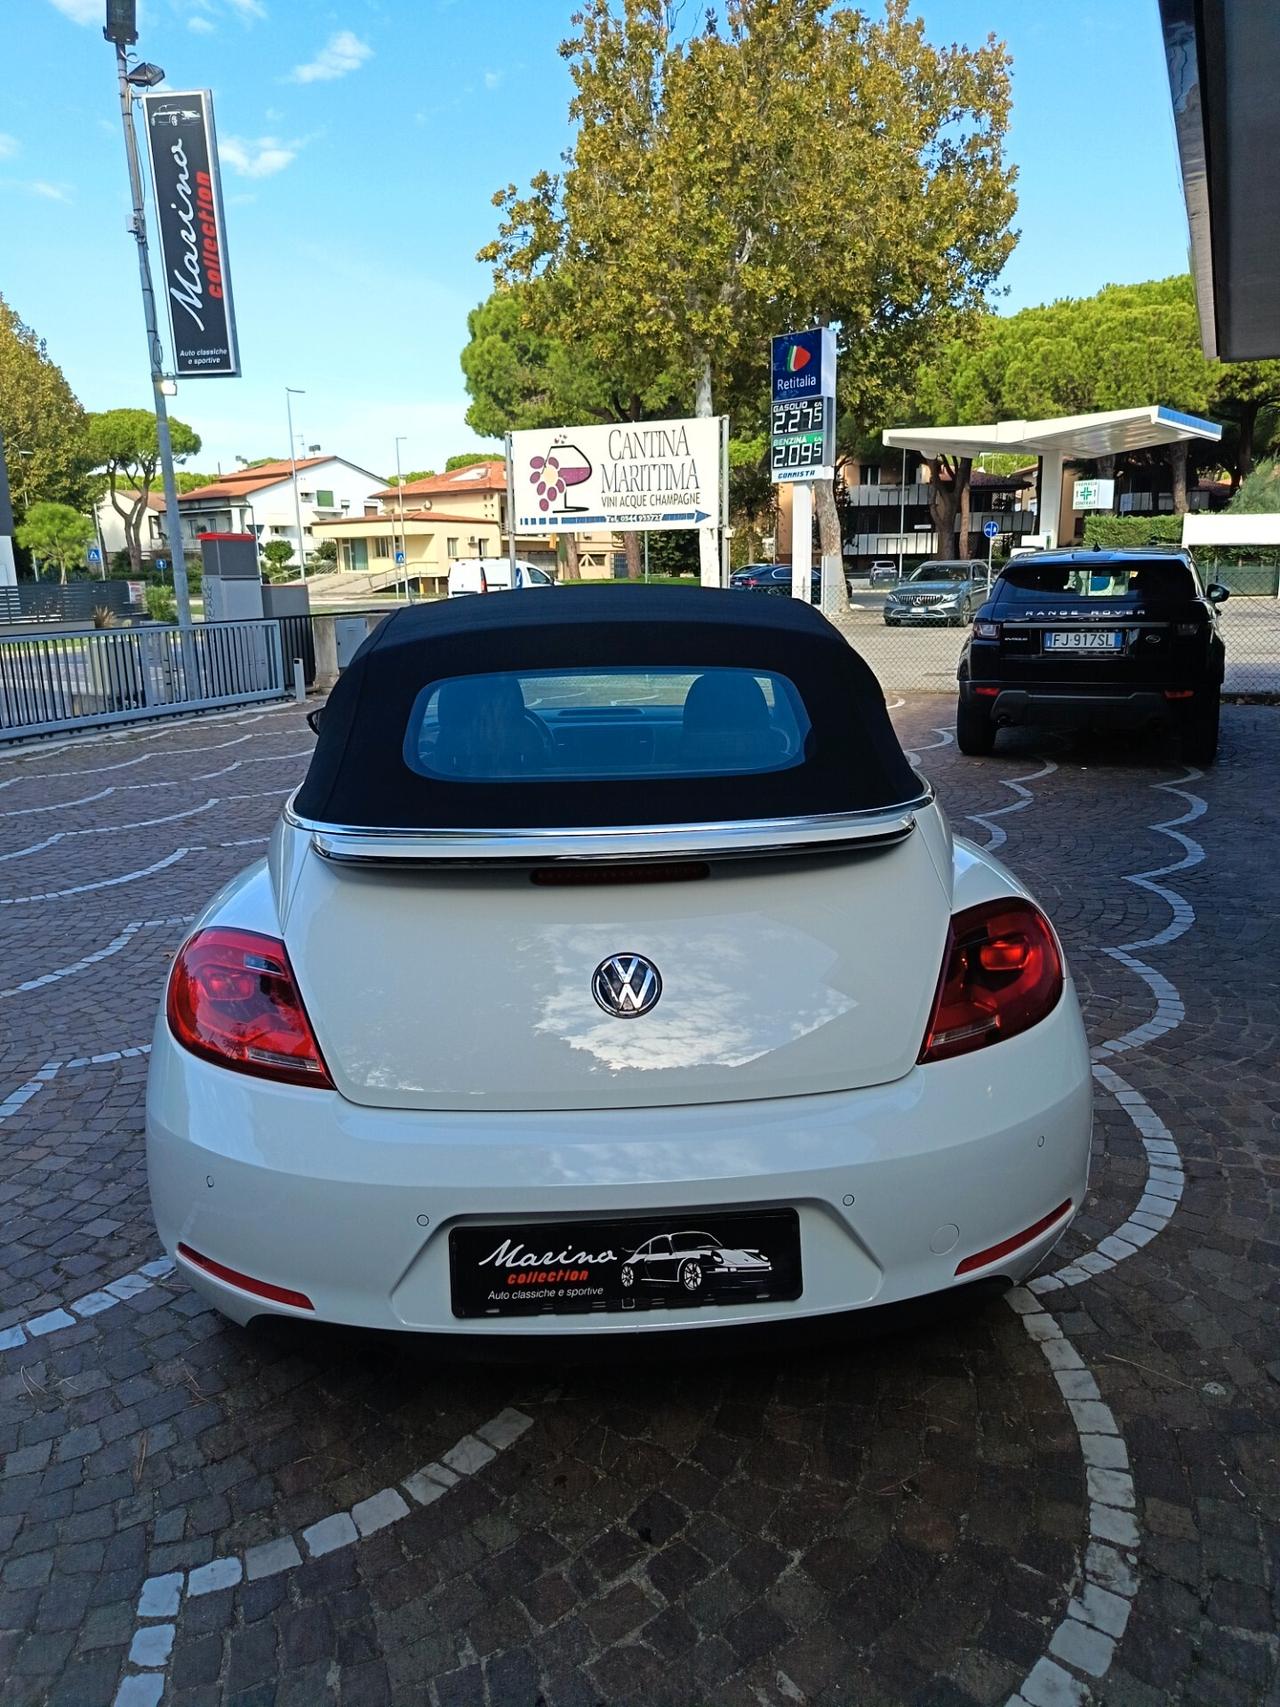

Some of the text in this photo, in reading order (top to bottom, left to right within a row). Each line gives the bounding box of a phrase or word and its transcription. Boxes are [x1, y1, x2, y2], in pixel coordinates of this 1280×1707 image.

[170, 138, 204, 331] Marino
[196, 171, 223, 299] collection
[180, 347, 228, 357] Auto classiche
[194, 356, 221, 366] sportive
[777, 374, 817, 391] Retitalia
[773, 401, 808, 413] GASOLIO
[608, 425, 691, 461] CANTINA
[773, 435, 807, 447] BENZINA
[601, 459, 700, 493] MARITTIMA
[601, 492, 701, 509] VINI ACQUE CHAMPAGNE
[478, 1238, 618, 1268] Marino
[507, 1269, 589, 1285] collection
[488, 1286, 604, 1300] Auto classiche e sportive
